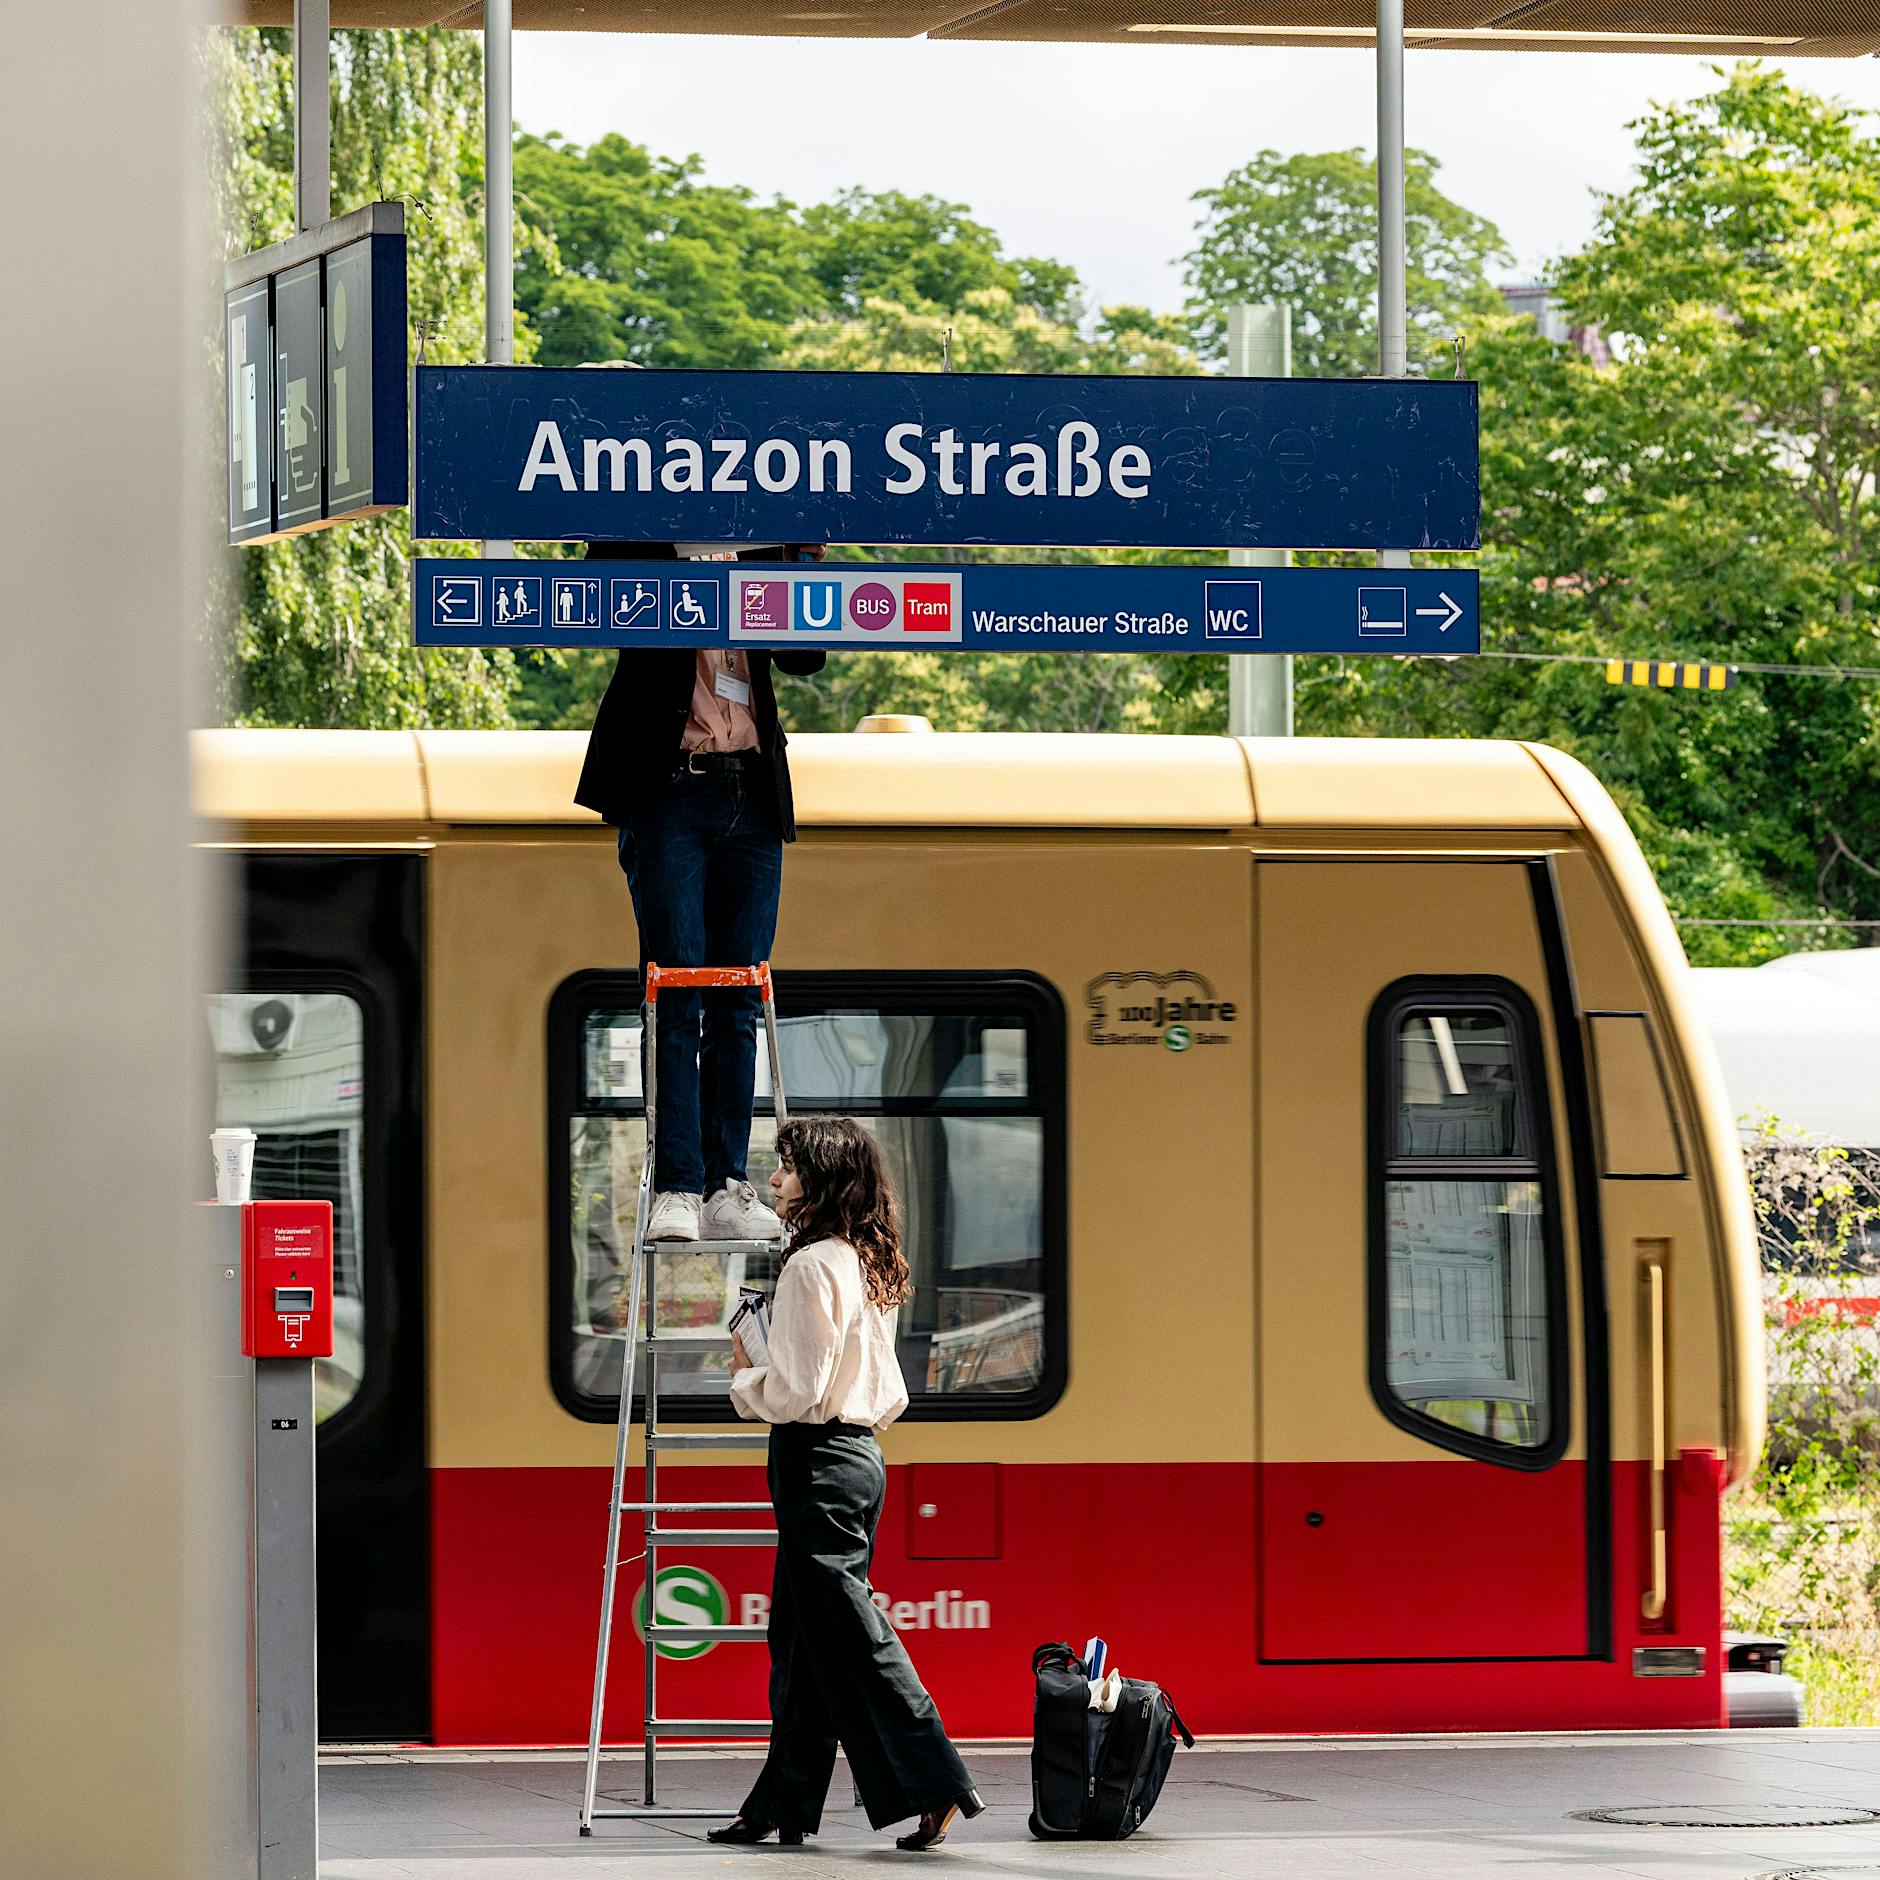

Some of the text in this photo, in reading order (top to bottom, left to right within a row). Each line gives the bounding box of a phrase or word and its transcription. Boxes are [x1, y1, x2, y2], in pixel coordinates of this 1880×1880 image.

[517, 420, 852, 493] Amazon
[884, 421, 1152, 499] Straße
[745, 612, 771, 621] Ersatz
[803, 585, 833, 628] U
[856, 599, 890, 615] BUS
[907, 599, 949, 616] Tram
[971, 610, 1189, 635] Warschauer Straße
[1209, 609, 1250, 632] WC
[1153, 997, 1236, 1028] Jahre
[656, 1576, 713, 1650] S
